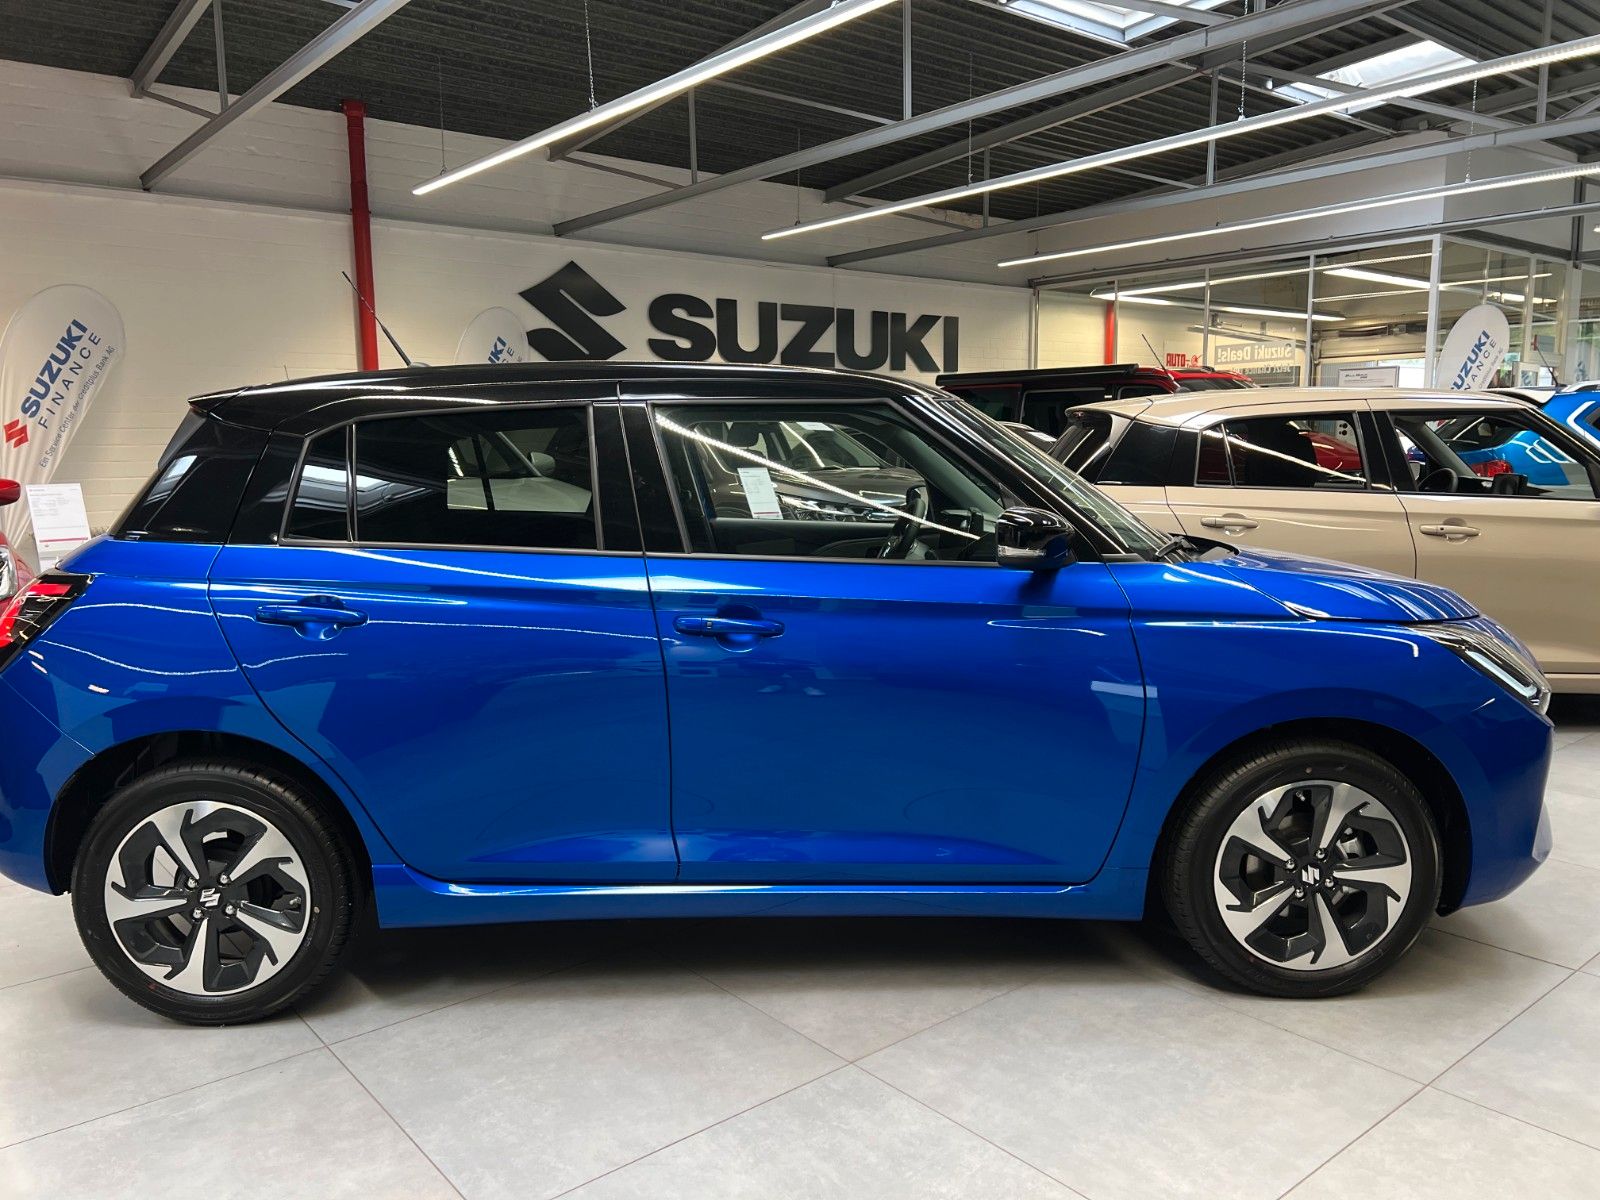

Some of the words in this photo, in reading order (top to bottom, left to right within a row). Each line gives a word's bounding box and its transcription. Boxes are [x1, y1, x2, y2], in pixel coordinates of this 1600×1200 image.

[21, 319, 88, 419] SUZUKI
[38, 331, 102, 430] FINANCE
[647, 293, 959, 373] SUZUKI
[1451, 330, 1491, 390] UZUKI
[40, 456, 50, 468] Ein
[60, 411, 75, 433] Center
[96, 357, 107, 371] Bank
[106, 346, 116, 357] AG
